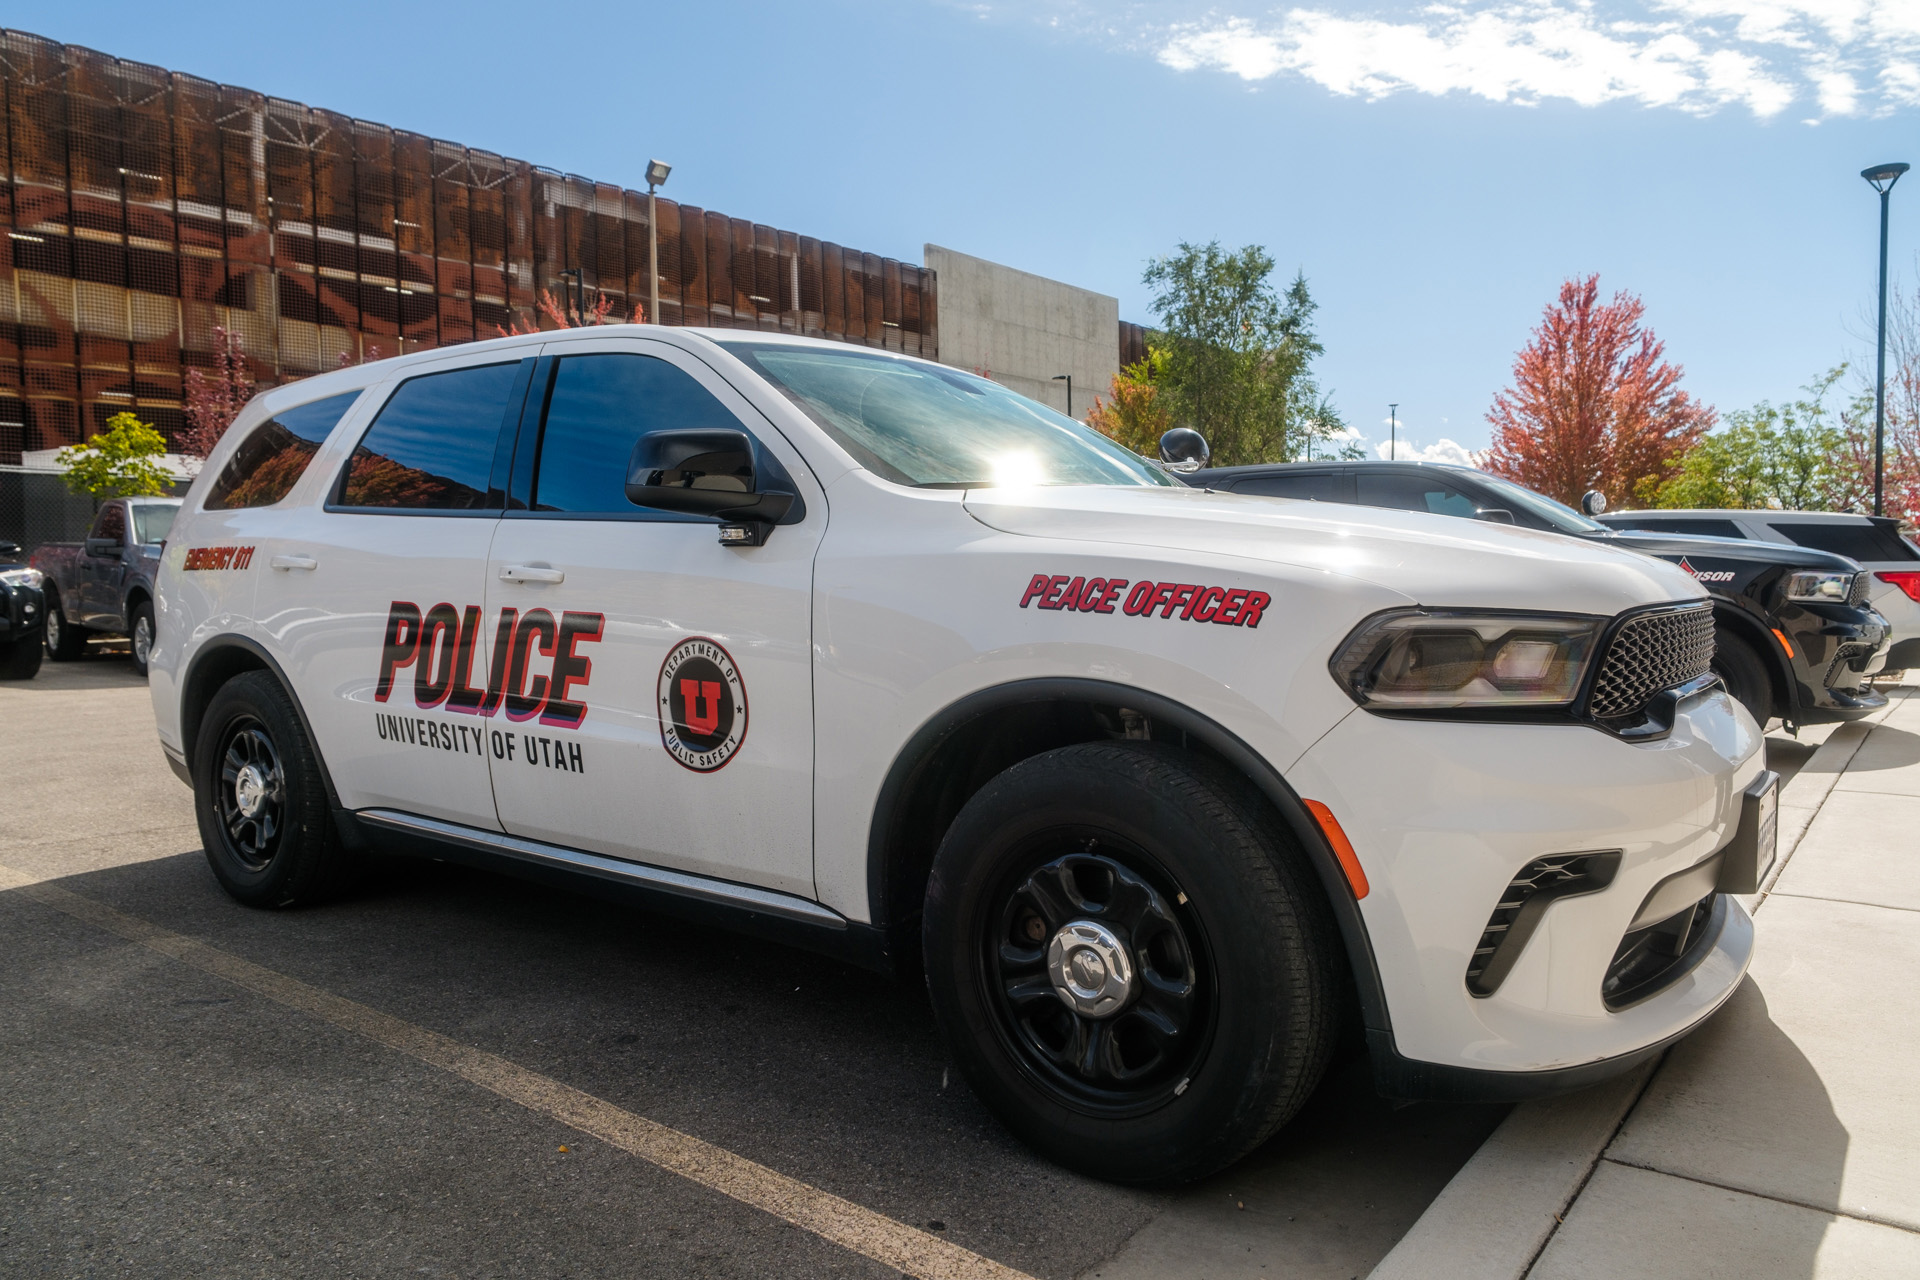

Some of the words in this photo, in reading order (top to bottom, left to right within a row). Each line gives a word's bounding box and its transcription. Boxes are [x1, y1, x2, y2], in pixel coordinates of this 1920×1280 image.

[183, 547, 237, 571] EMERGENCY
[233, 546, 255, 570] 911
[1019, 574, 1129, 614] PEACE
[1123, 581, 1271, 628] OFFICER
[375, 601, 605, 730] POLICE
[664, 643, 726, 680] DEPARTMENT
[725, 667, 738, 685] OF
[680, 678, 721, 736] U
[376, 713, 482, 756] UNIVERSITY
[491, 730, 516, 761] OF
[524, 735, 584, 774] UTAH
[666, 727, 694, 765] PUBLIC
[700, 735, 736, 766] SAFETY
